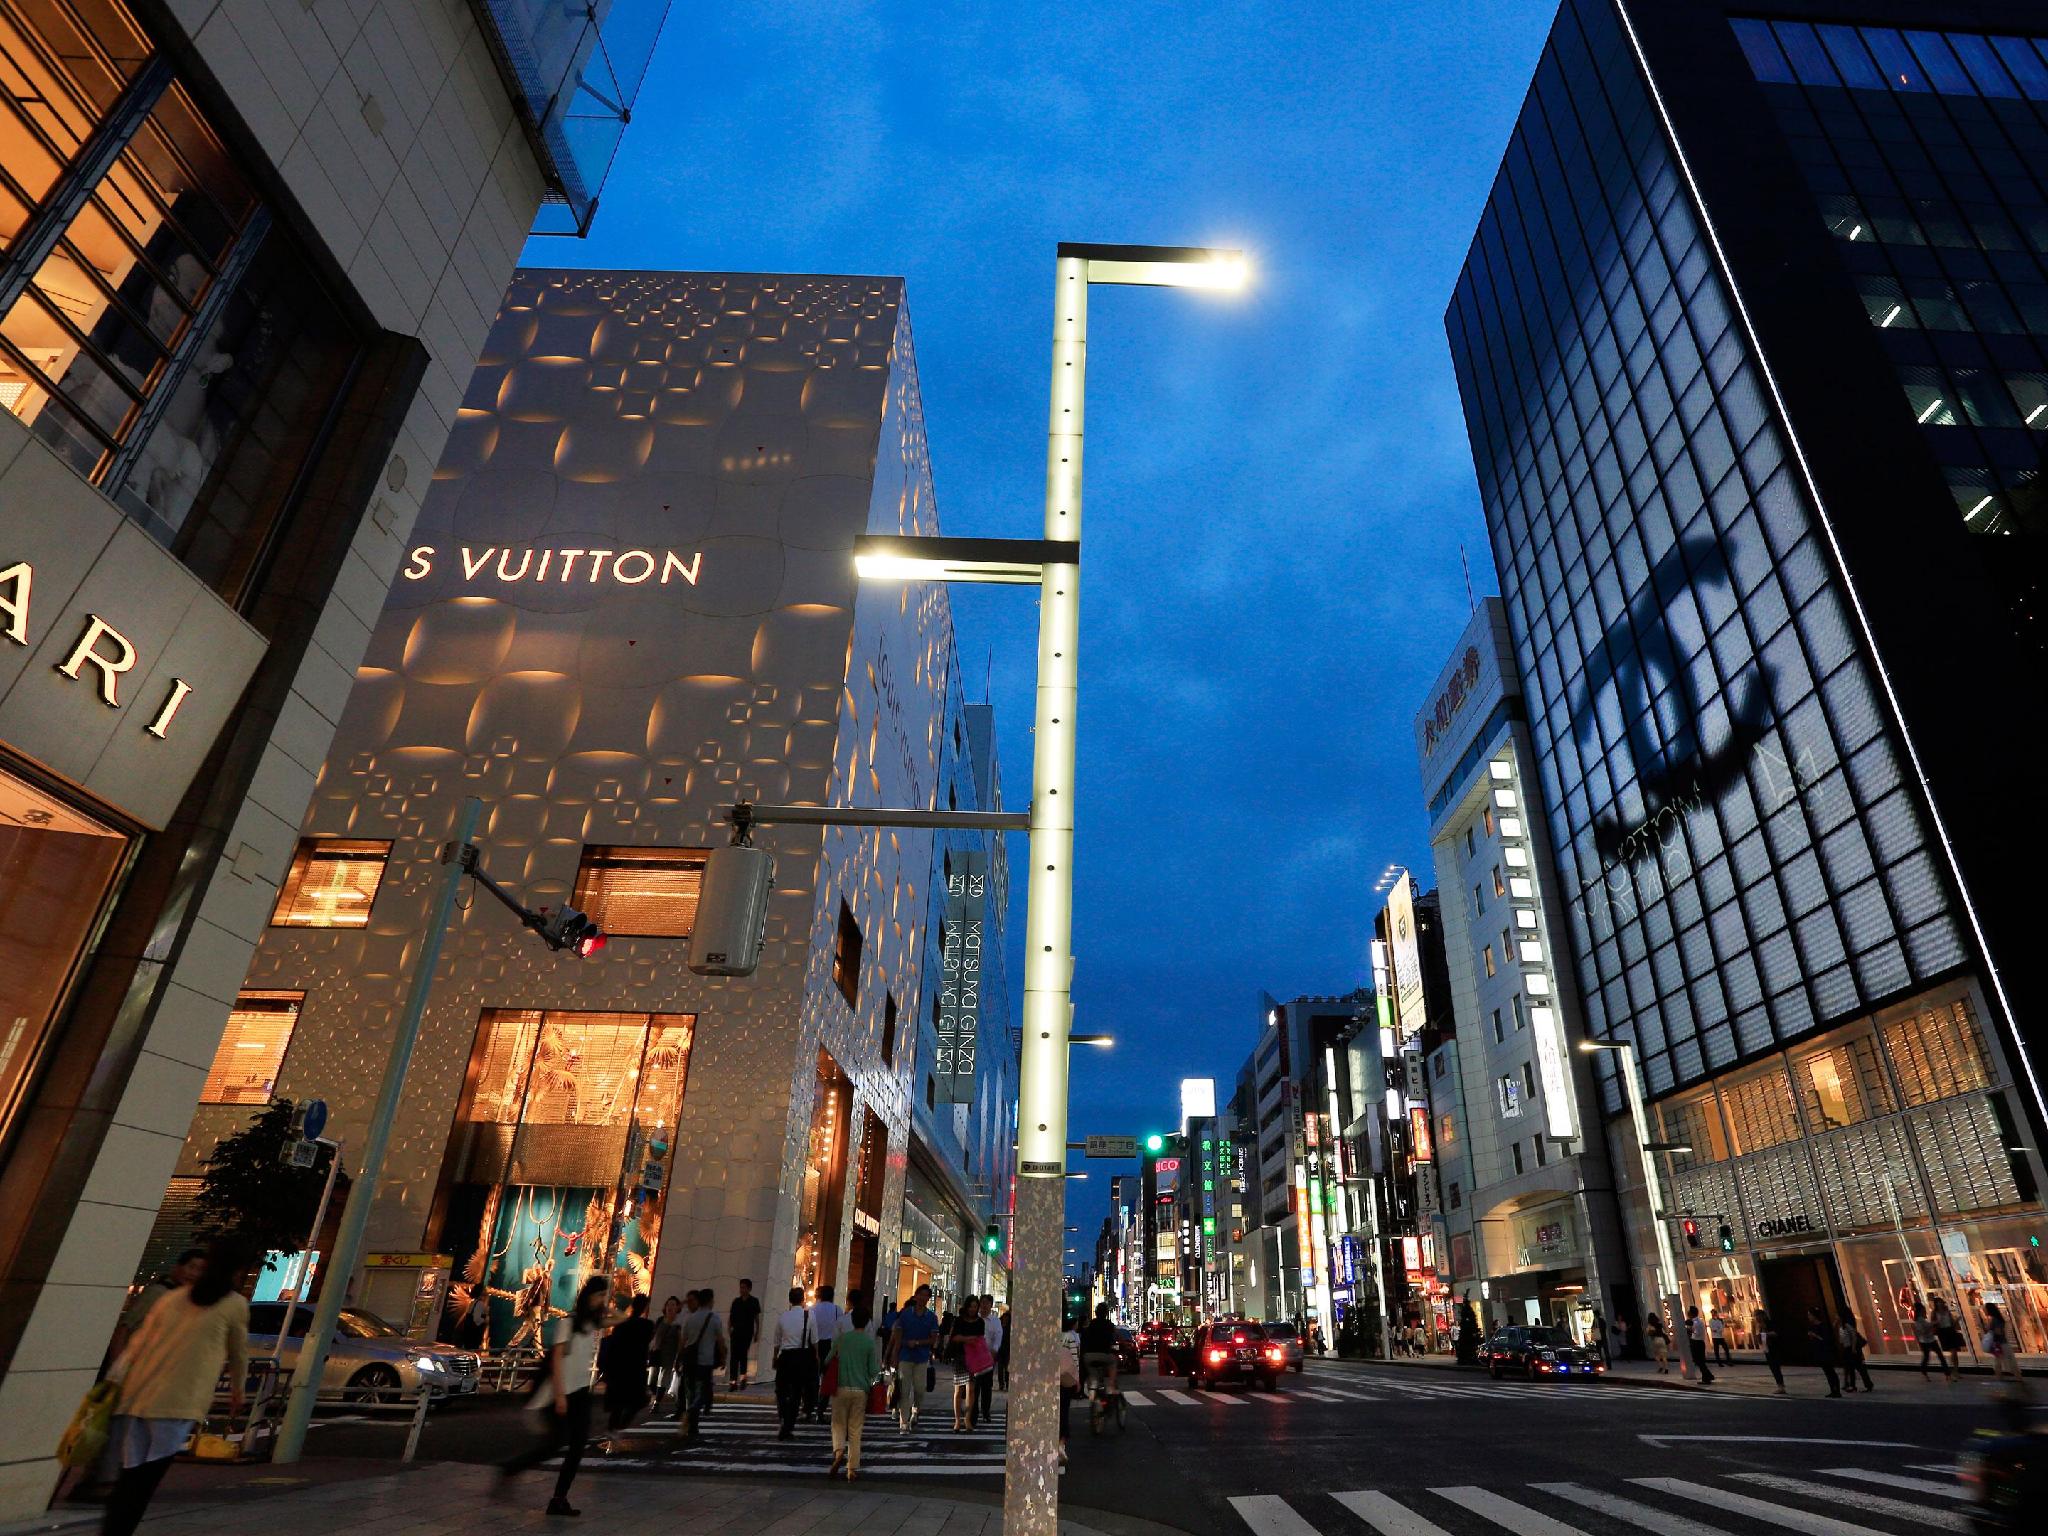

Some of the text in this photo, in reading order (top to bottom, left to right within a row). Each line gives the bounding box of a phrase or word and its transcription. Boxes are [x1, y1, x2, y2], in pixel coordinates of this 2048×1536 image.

[403, 545, 703, 586] S VUITTON
[0, 560, 193, 740] ARI
[1758, 1215, 1816, 1238] CHANEL
